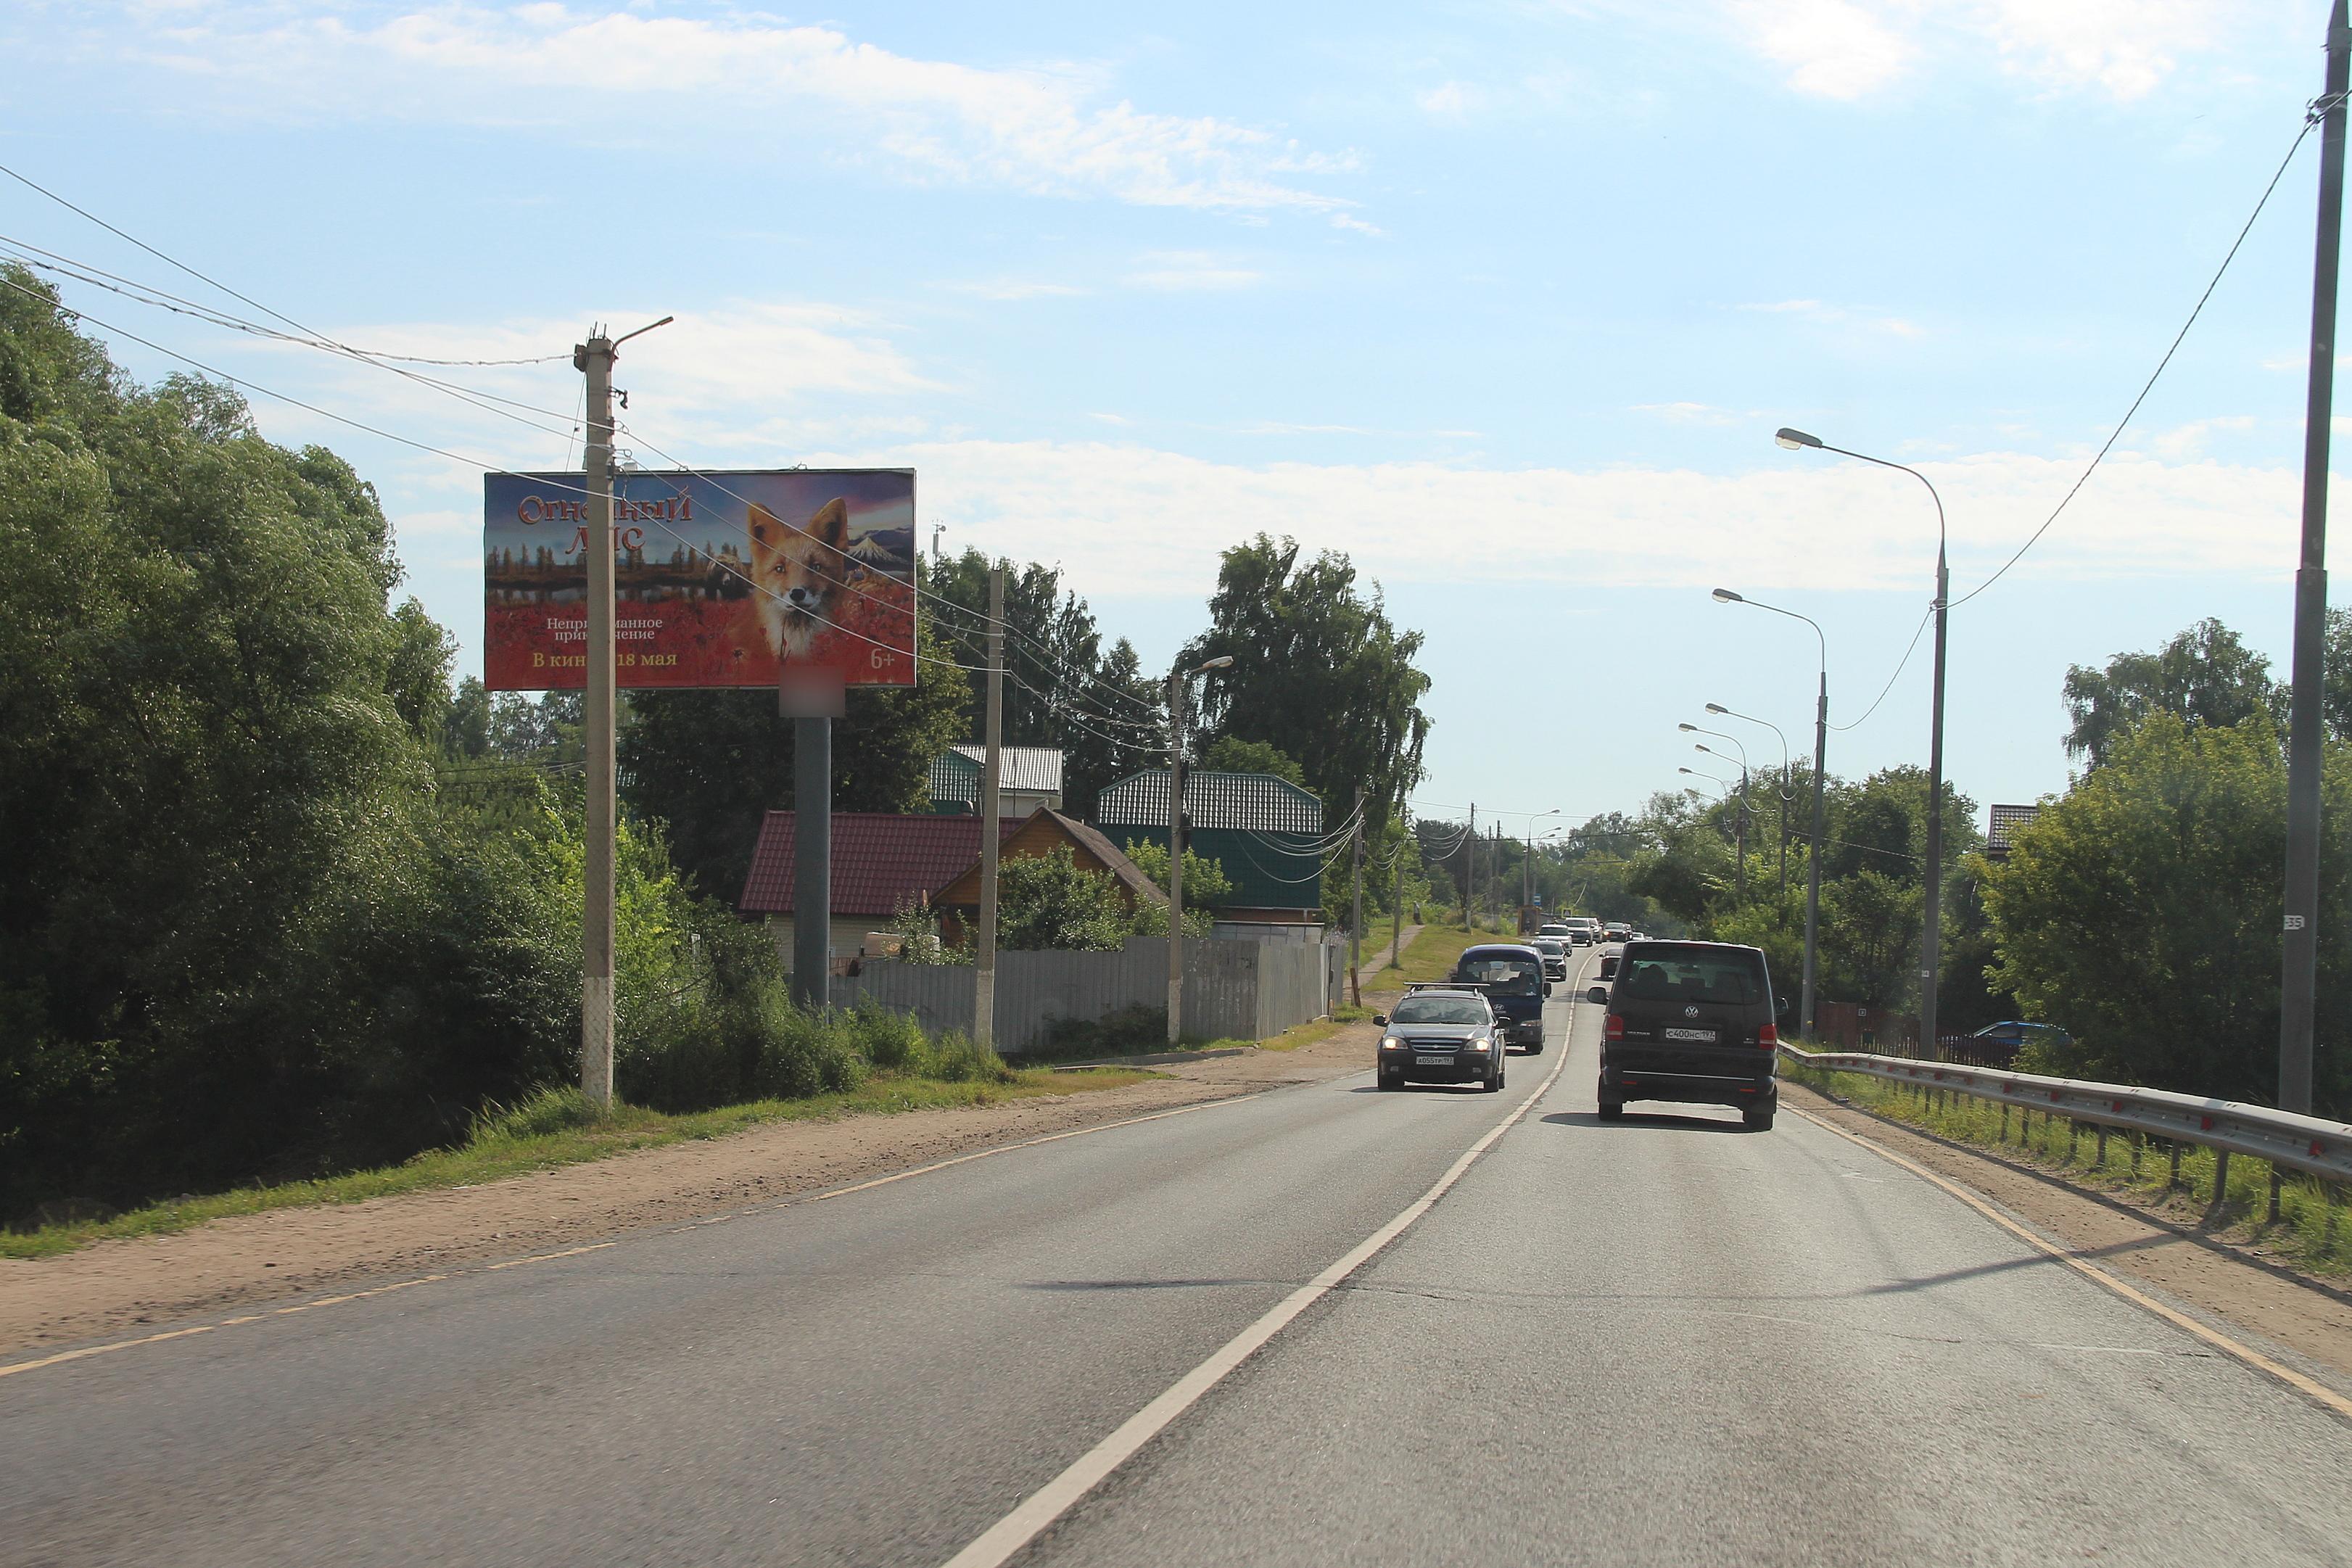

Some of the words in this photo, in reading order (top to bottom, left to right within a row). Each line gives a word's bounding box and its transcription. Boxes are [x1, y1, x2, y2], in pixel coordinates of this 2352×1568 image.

[532, 652, 545, 667] В
[550, 655, 587, 667] кин
[618, 653, 635, 667] 18
[640, 654, 677, 667] мая
[871, 648, 895, 669] 6+
